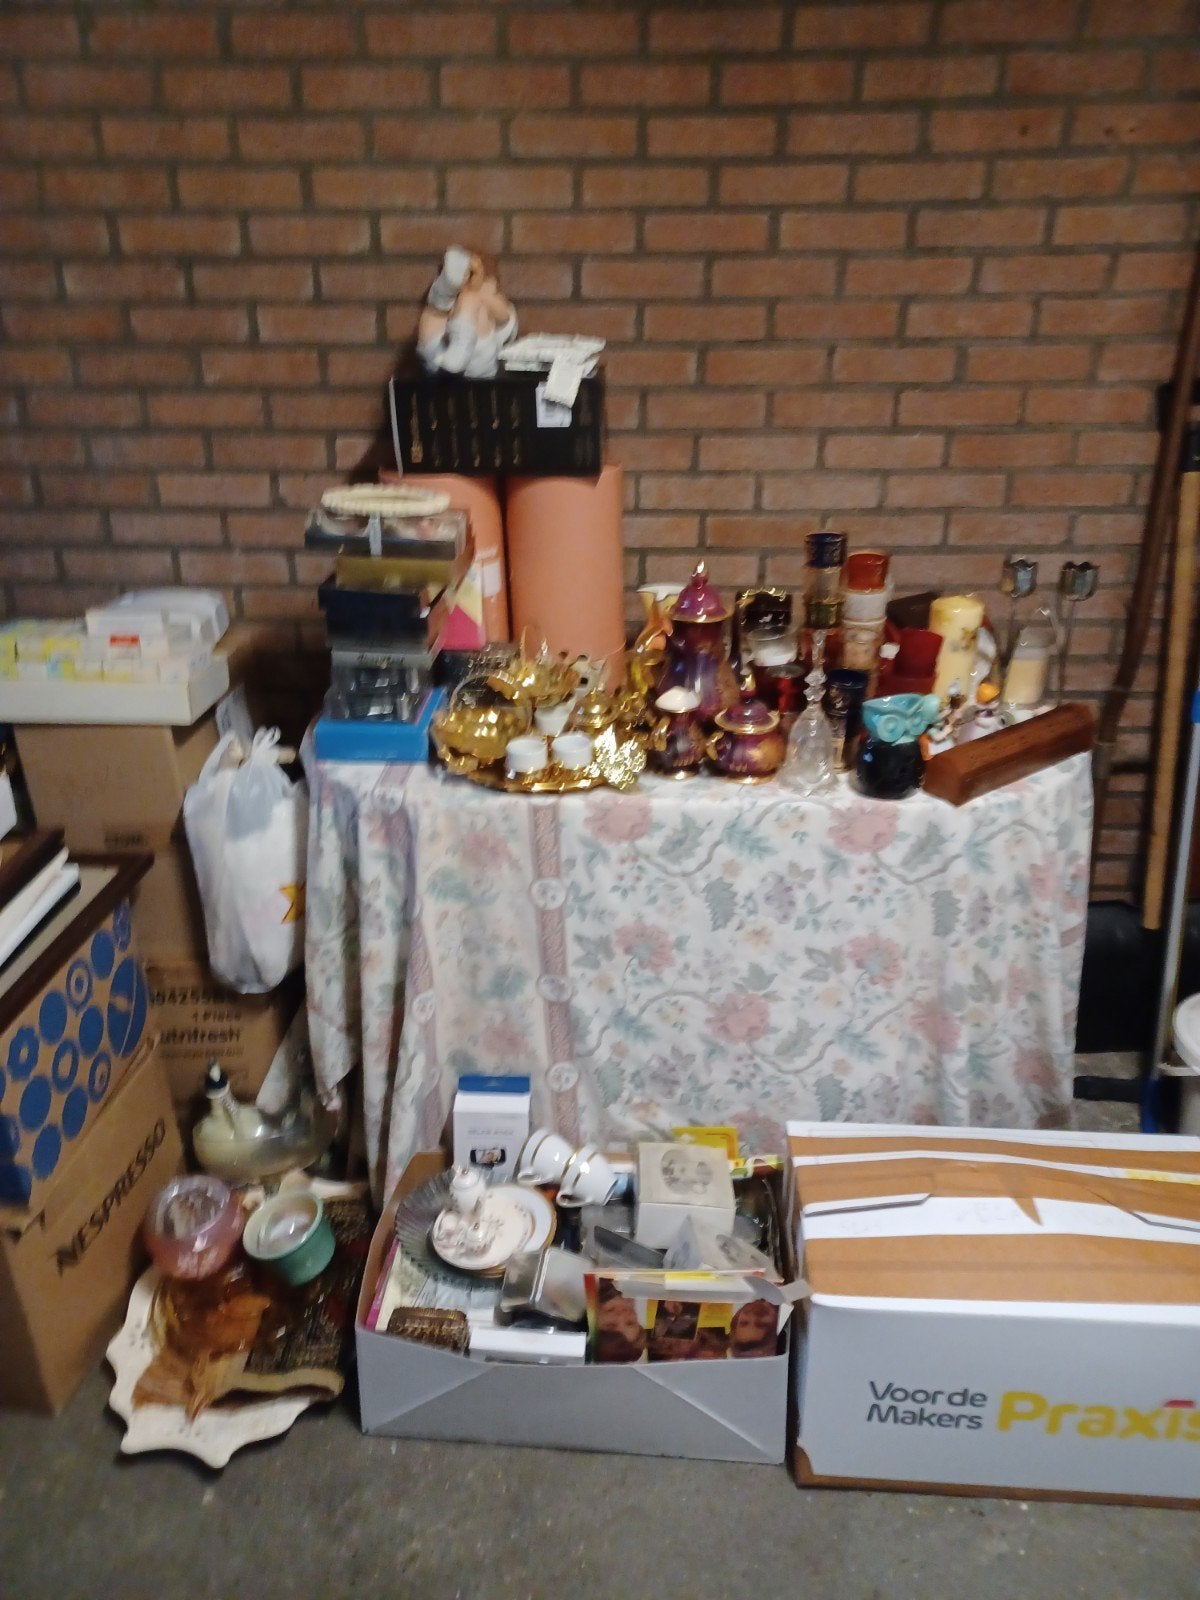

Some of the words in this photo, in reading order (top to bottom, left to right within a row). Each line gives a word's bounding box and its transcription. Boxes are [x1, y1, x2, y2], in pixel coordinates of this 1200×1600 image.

[868, 1380, 943, 1406] Voor
[948, 1388, 988, 1408] de
[866, 1403, 984, 1430] Makers
